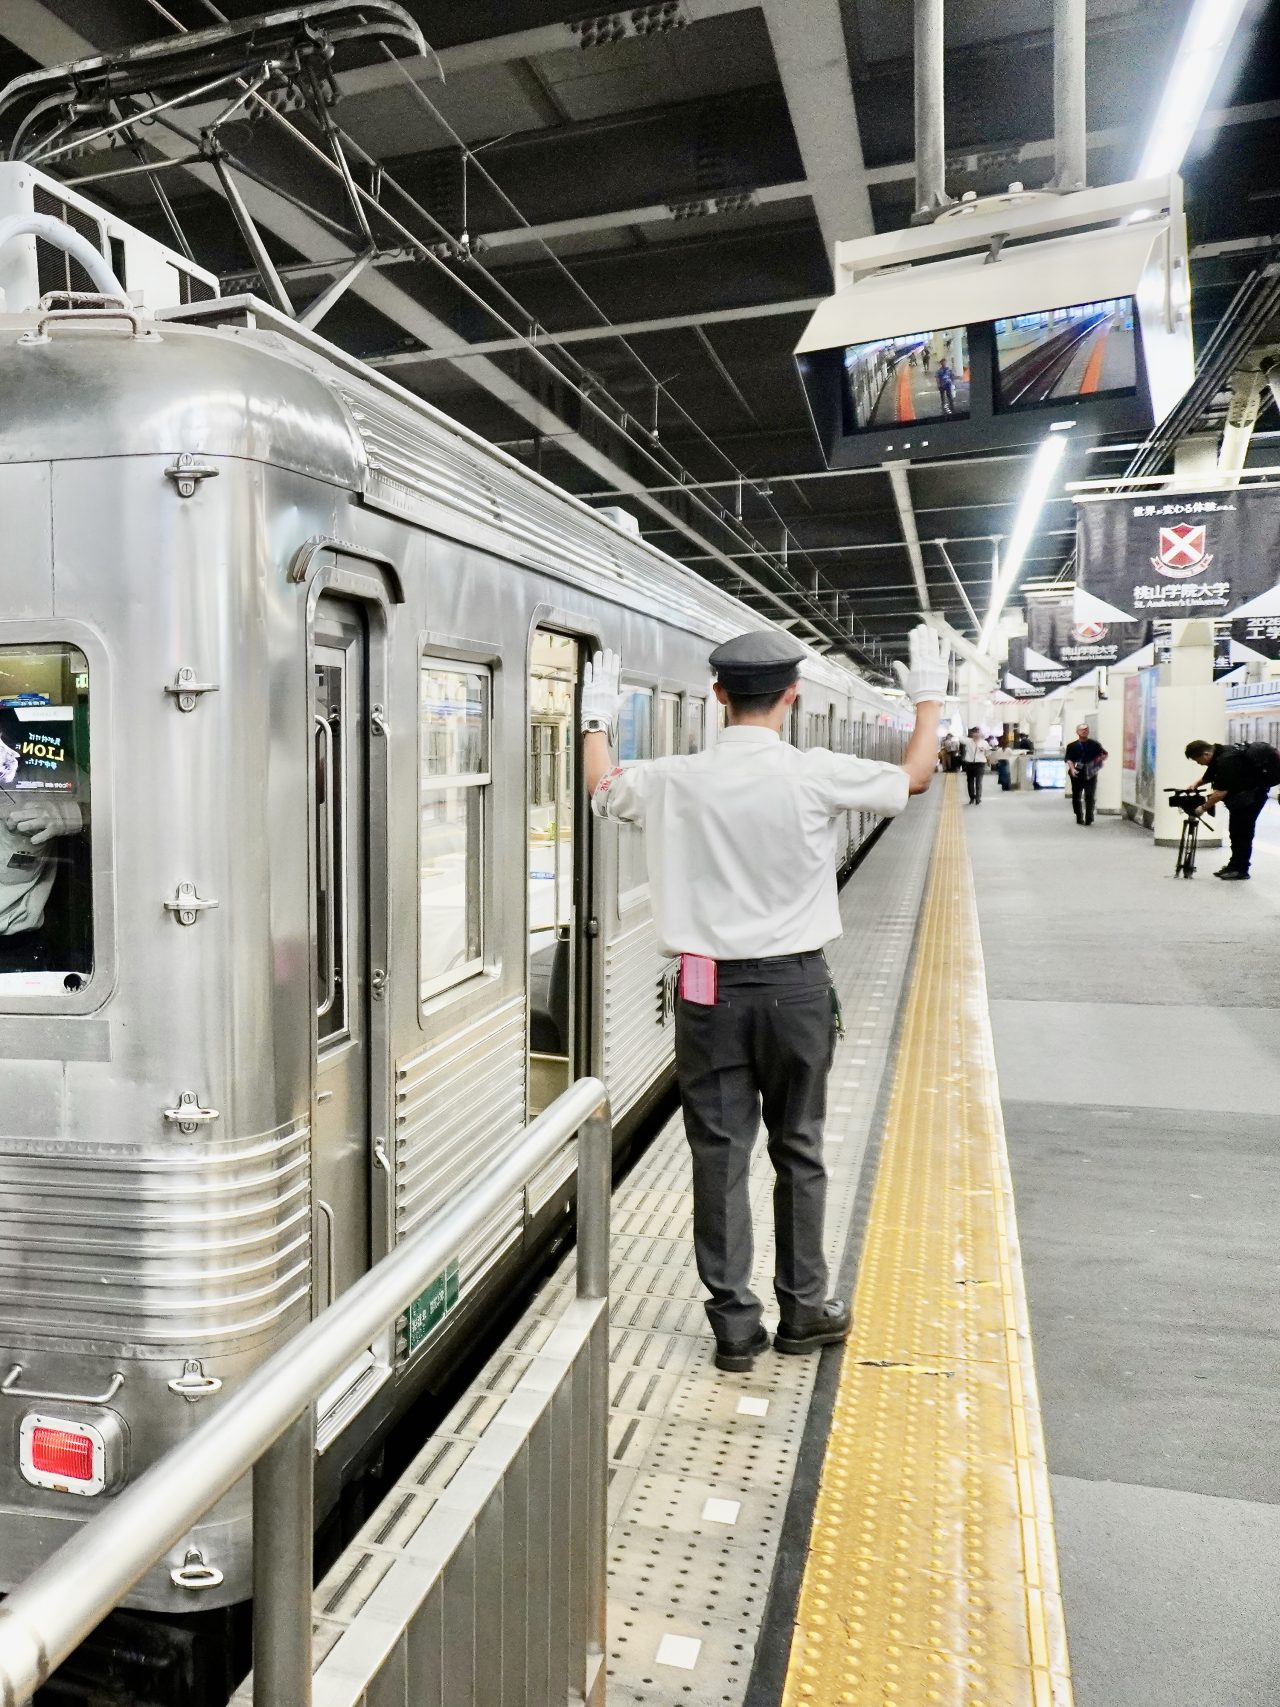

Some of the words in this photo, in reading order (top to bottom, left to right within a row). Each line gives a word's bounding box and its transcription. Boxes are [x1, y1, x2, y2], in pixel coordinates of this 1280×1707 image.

[1133, 582, 1230, 600] 桃山学院大学
[1146, 599, 1186, 608] Andrew's
[1186, 597, 1230, 607] University
